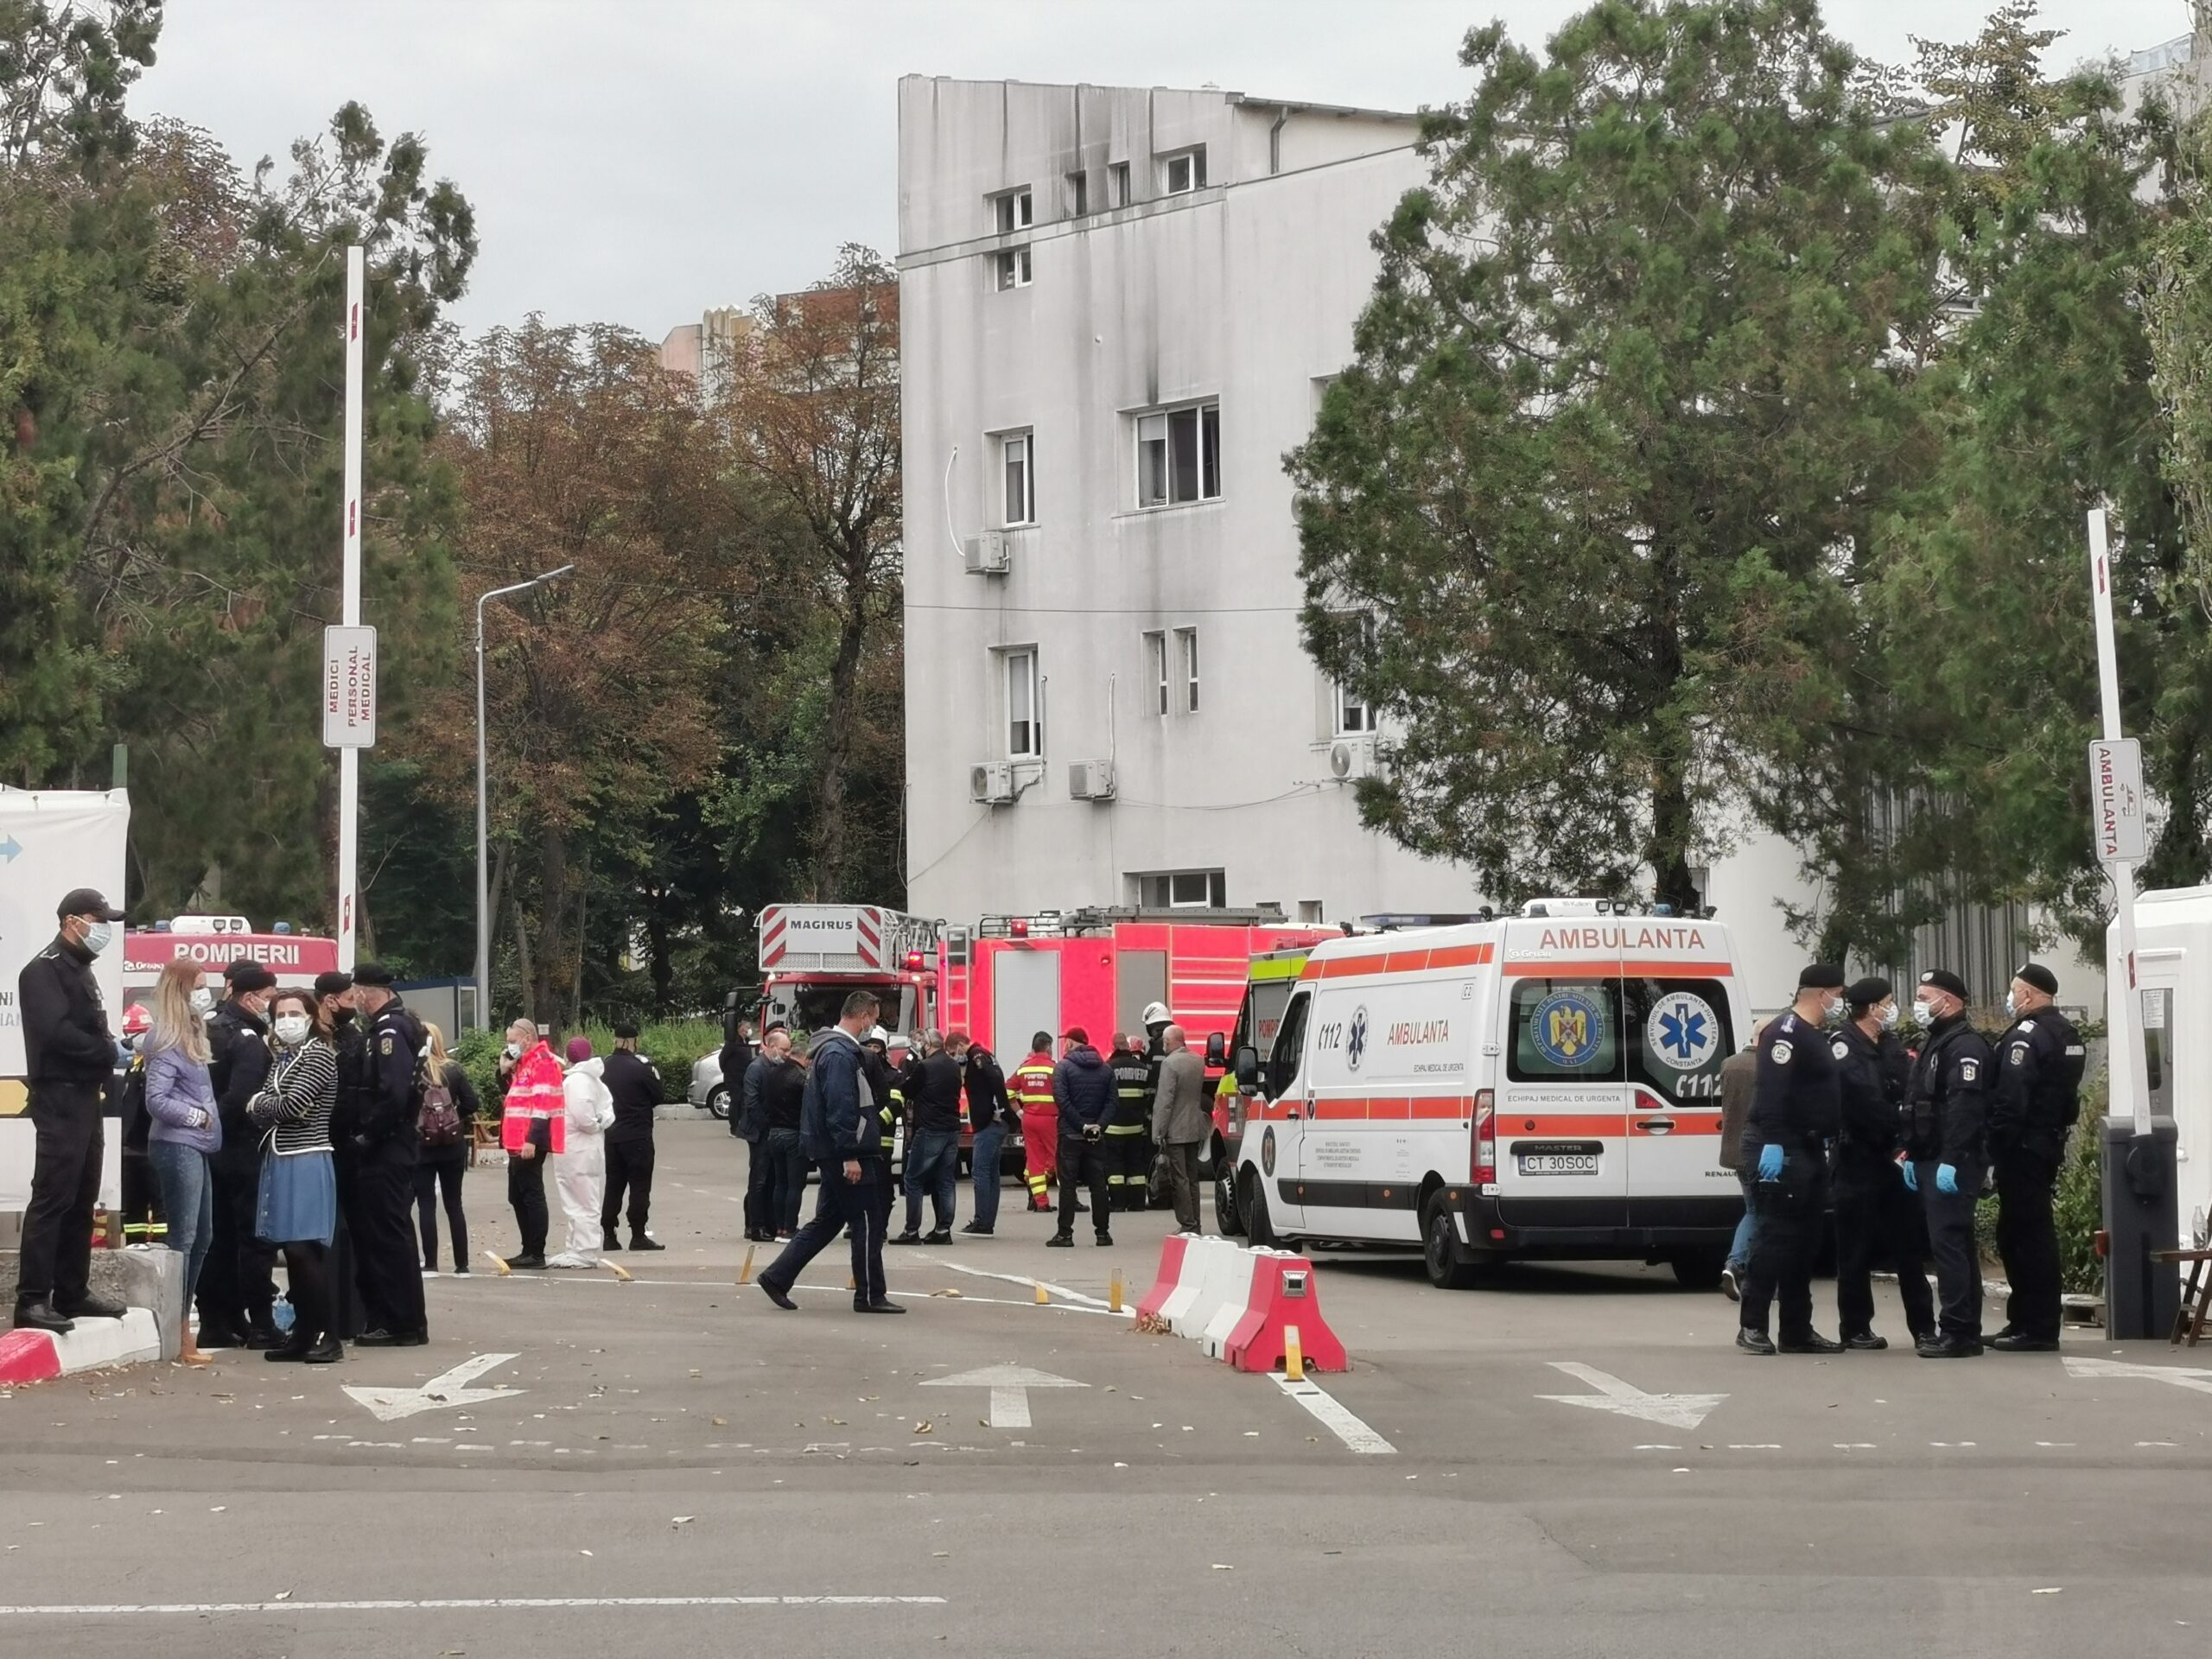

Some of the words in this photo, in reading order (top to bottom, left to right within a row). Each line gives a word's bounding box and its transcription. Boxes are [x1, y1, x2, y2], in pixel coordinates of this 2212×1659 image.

[329, 659, 339, 713] MEDICI
[347, 645, 359, 728] PERSONAL
[361, 652, 371, 721] MEDICAL
[2099, 747, 2118, 855] AMBULANTA
[791, 920, 853, 930] MAGIRUS
[1540, 928, 1705, 949] AMBULANTA
[175, 943, 300, 964] POMPIERII
[1387, 1019, 1449, 1046] AMBULANTA
[1649, 1010, 1660, 1047] SERVICIUL
[1657, 1001, 1667, 1009] DE
[1666, 994, 1707, 1009] AMBULANTA
[1666, 1056, 1703, 1067] CONSTANTA
[1527, 1156, 1544, 1170] CT
[1549, 1155, 1594, 1170] 30SOC
